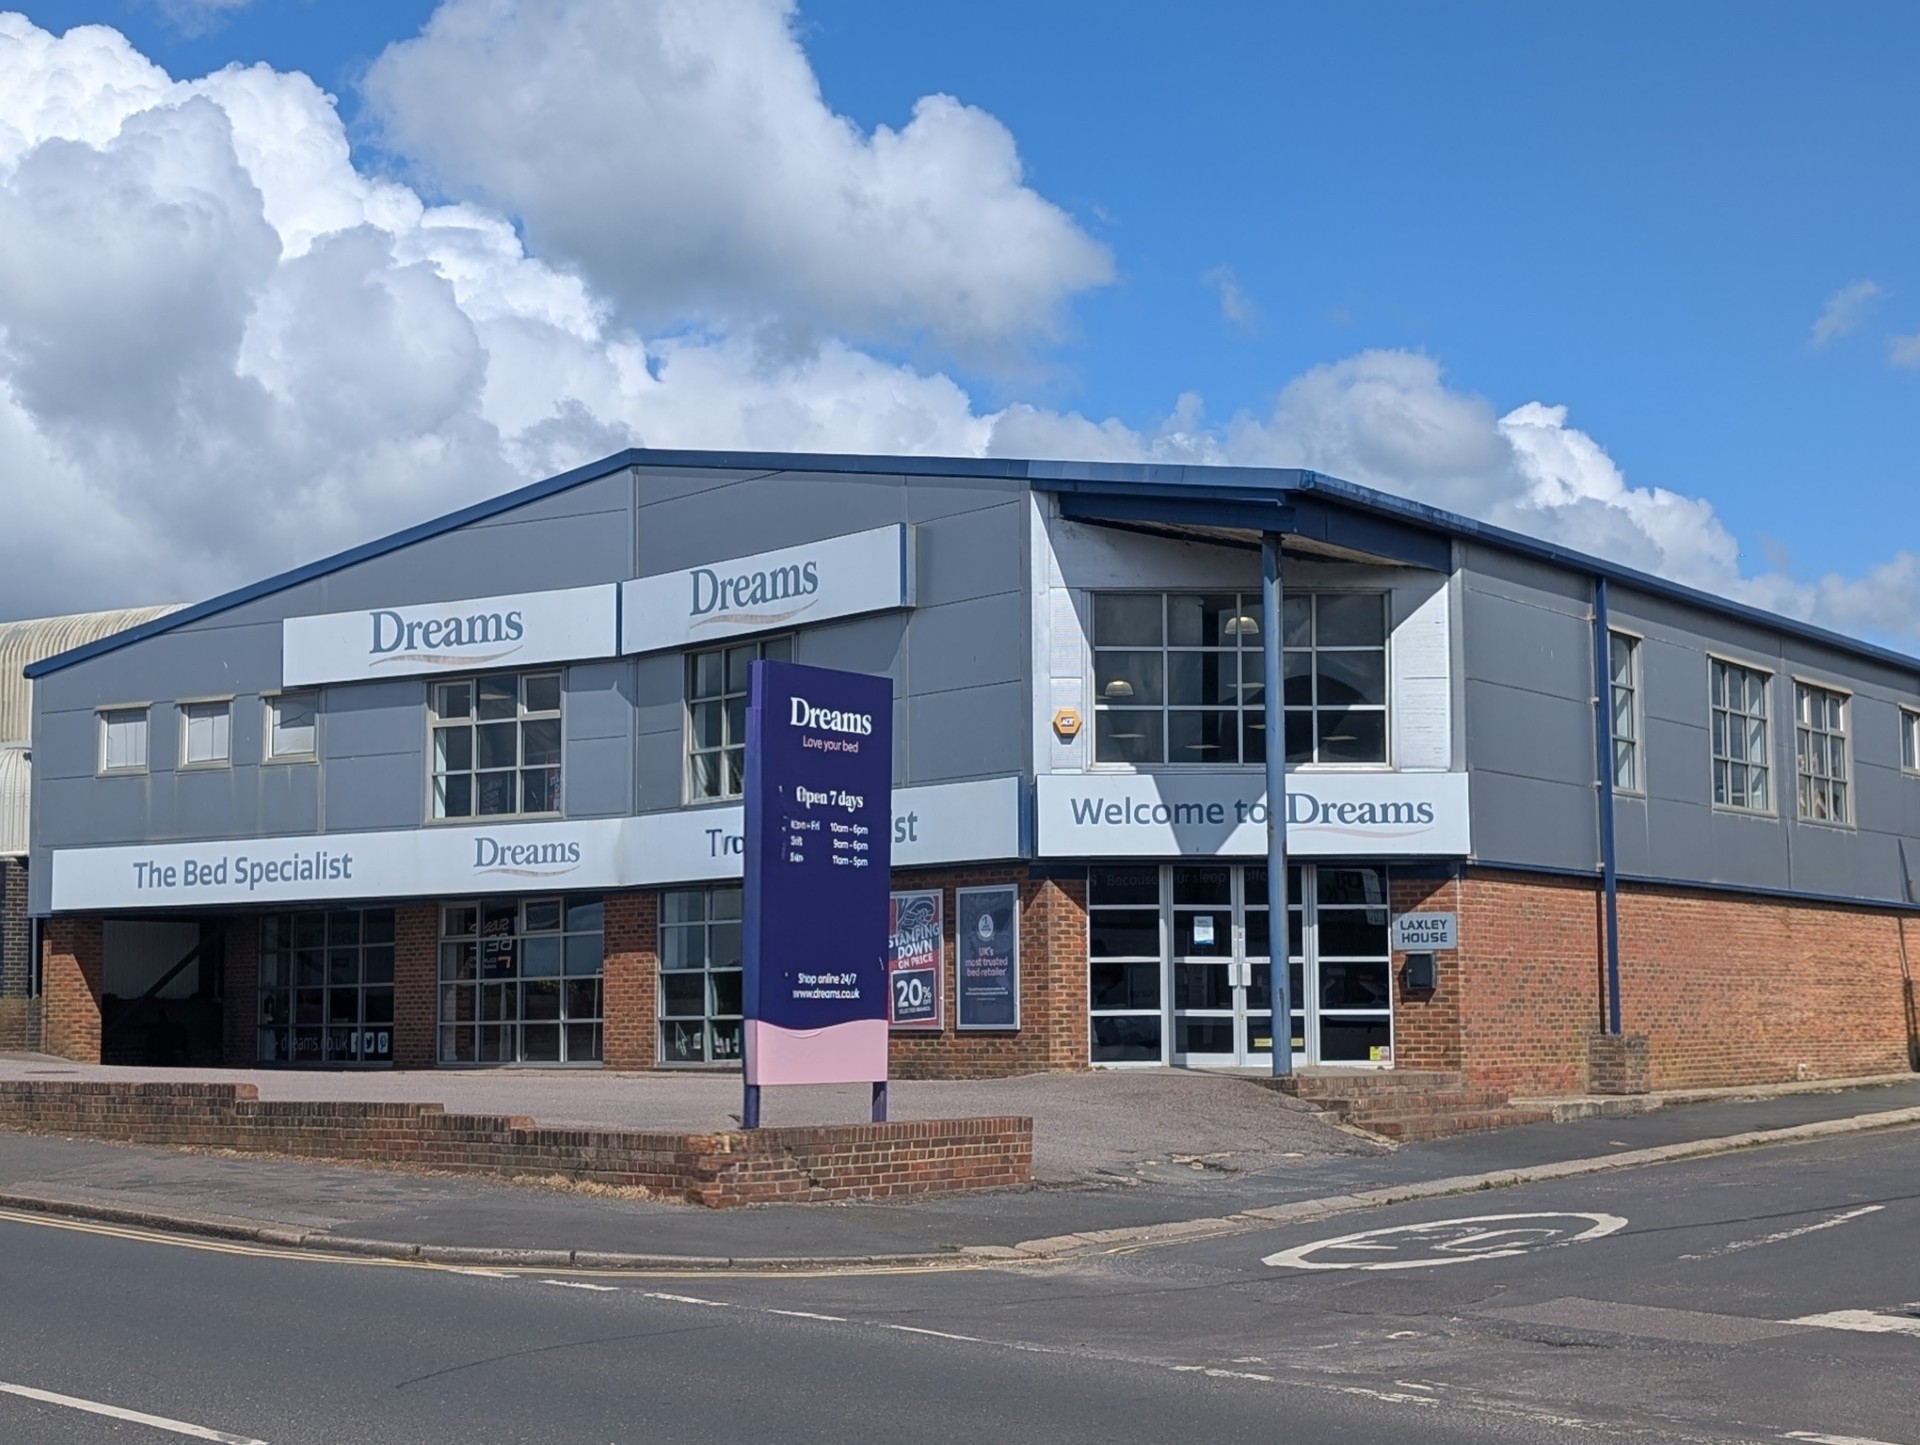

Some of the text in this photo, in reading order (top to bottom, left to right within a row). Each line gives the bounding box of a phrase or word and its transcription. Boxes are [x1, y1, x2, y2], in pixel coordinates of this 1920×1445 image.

[689, 560, 819, 617] Dreams
[368, 609, 524, 654] Dreams
[790, 696, 873, 736] Dreams
[802, 735, 859, 753] Love your bed
[796, 786, 864, 813] Open 7 days
[1070, 792, 1435, 825] Welcome to Dreams
[473, 836, 581, 868] Dreams
[133, 851, 353, 890] The Bed Specialist
[888, 922, 941, 949] STAMPING
[1400, 919, 1448, 930] LAXLEY
[1401, 932, 1448, 943] HOUSE
[897, 938, 933, 960] DOWN
[898, 952, 934, 970] ON PRICE
[983, 957, 1008, 967] trusted
[798, 972, 857, 986] Shop online 24/7
[792, 987, 860, 999] www.dreams.co.uk
[281, 1032, 348, 1051] deams.o.uk
